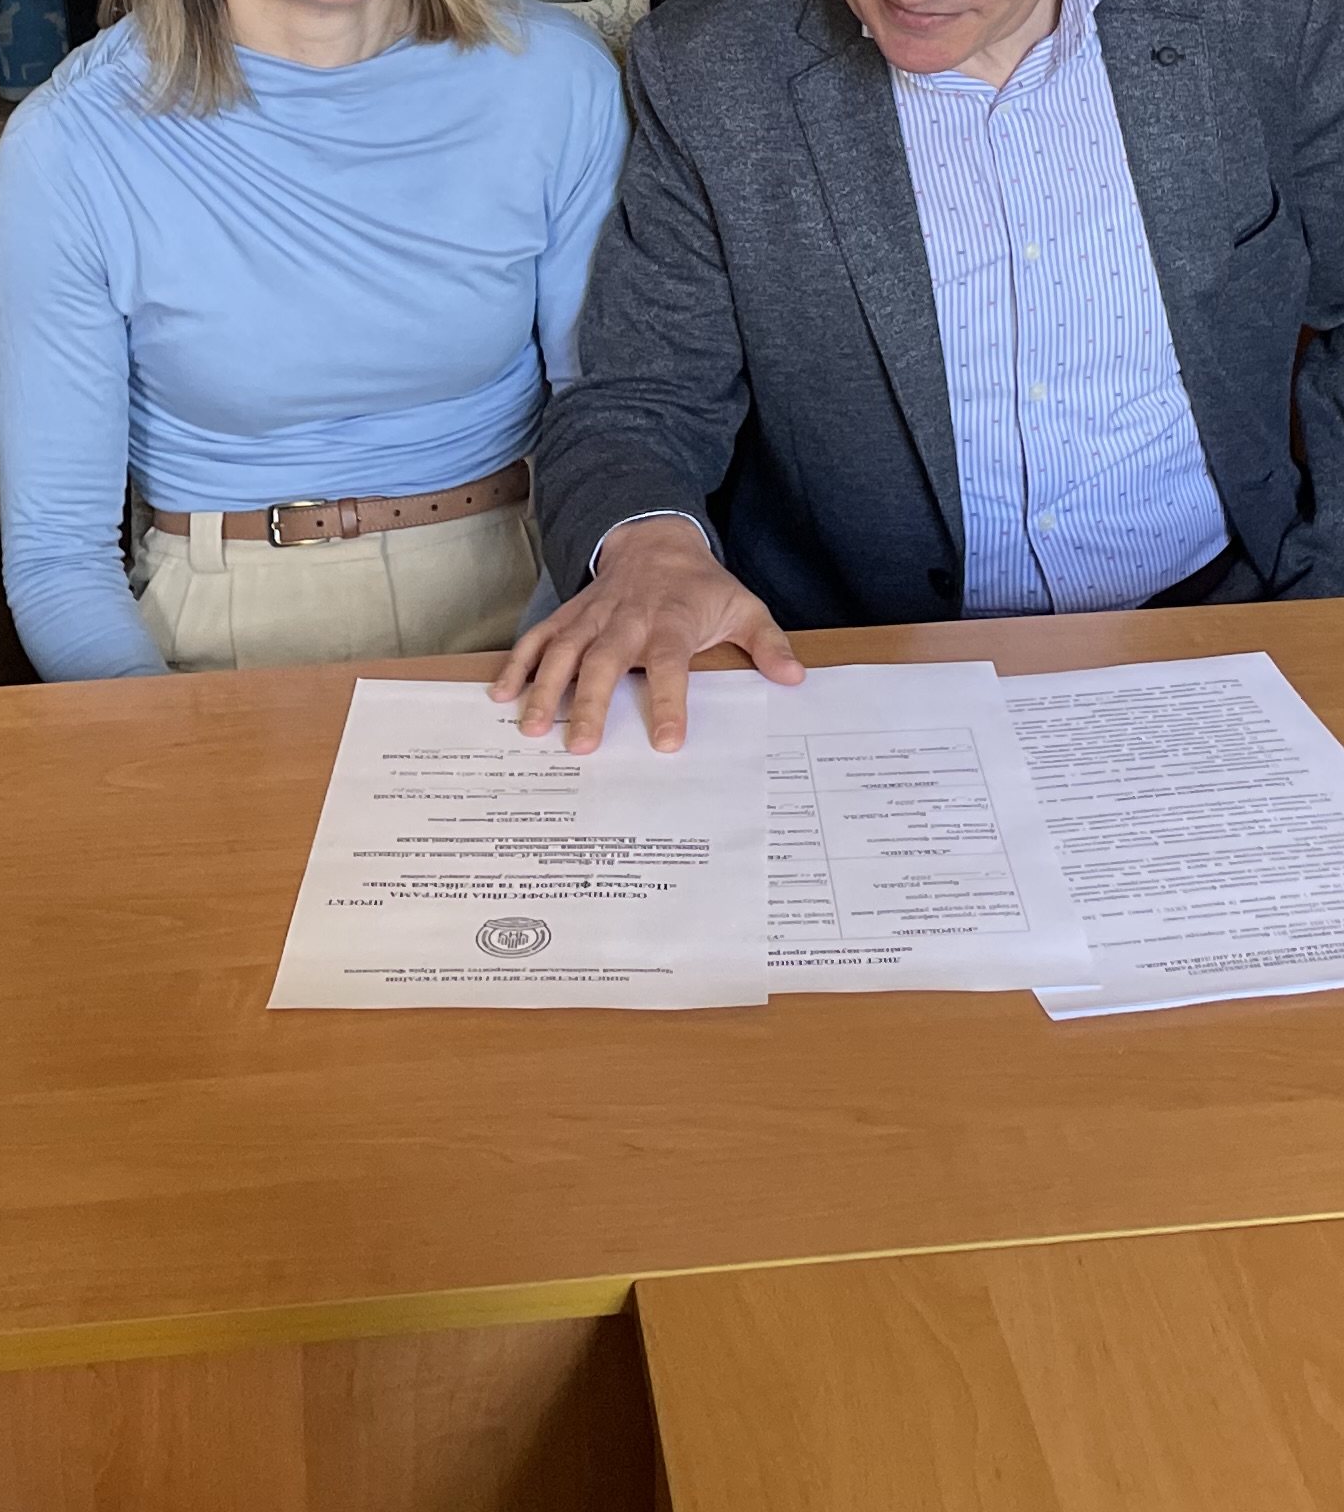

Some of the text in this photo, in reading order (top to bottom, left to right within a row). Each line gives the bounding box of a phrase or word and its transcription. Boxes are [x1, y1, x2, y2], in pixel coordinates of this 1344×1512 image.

[518, 879, 591, 889] філологія
[595, 880, 676, 890] «Польська
[388, 890, 647, 899] ОСВІТНЬО-ПРОФЕСІЙНА ПРОГРАМА
[864, 955, 901, 964] ЛИСТ
